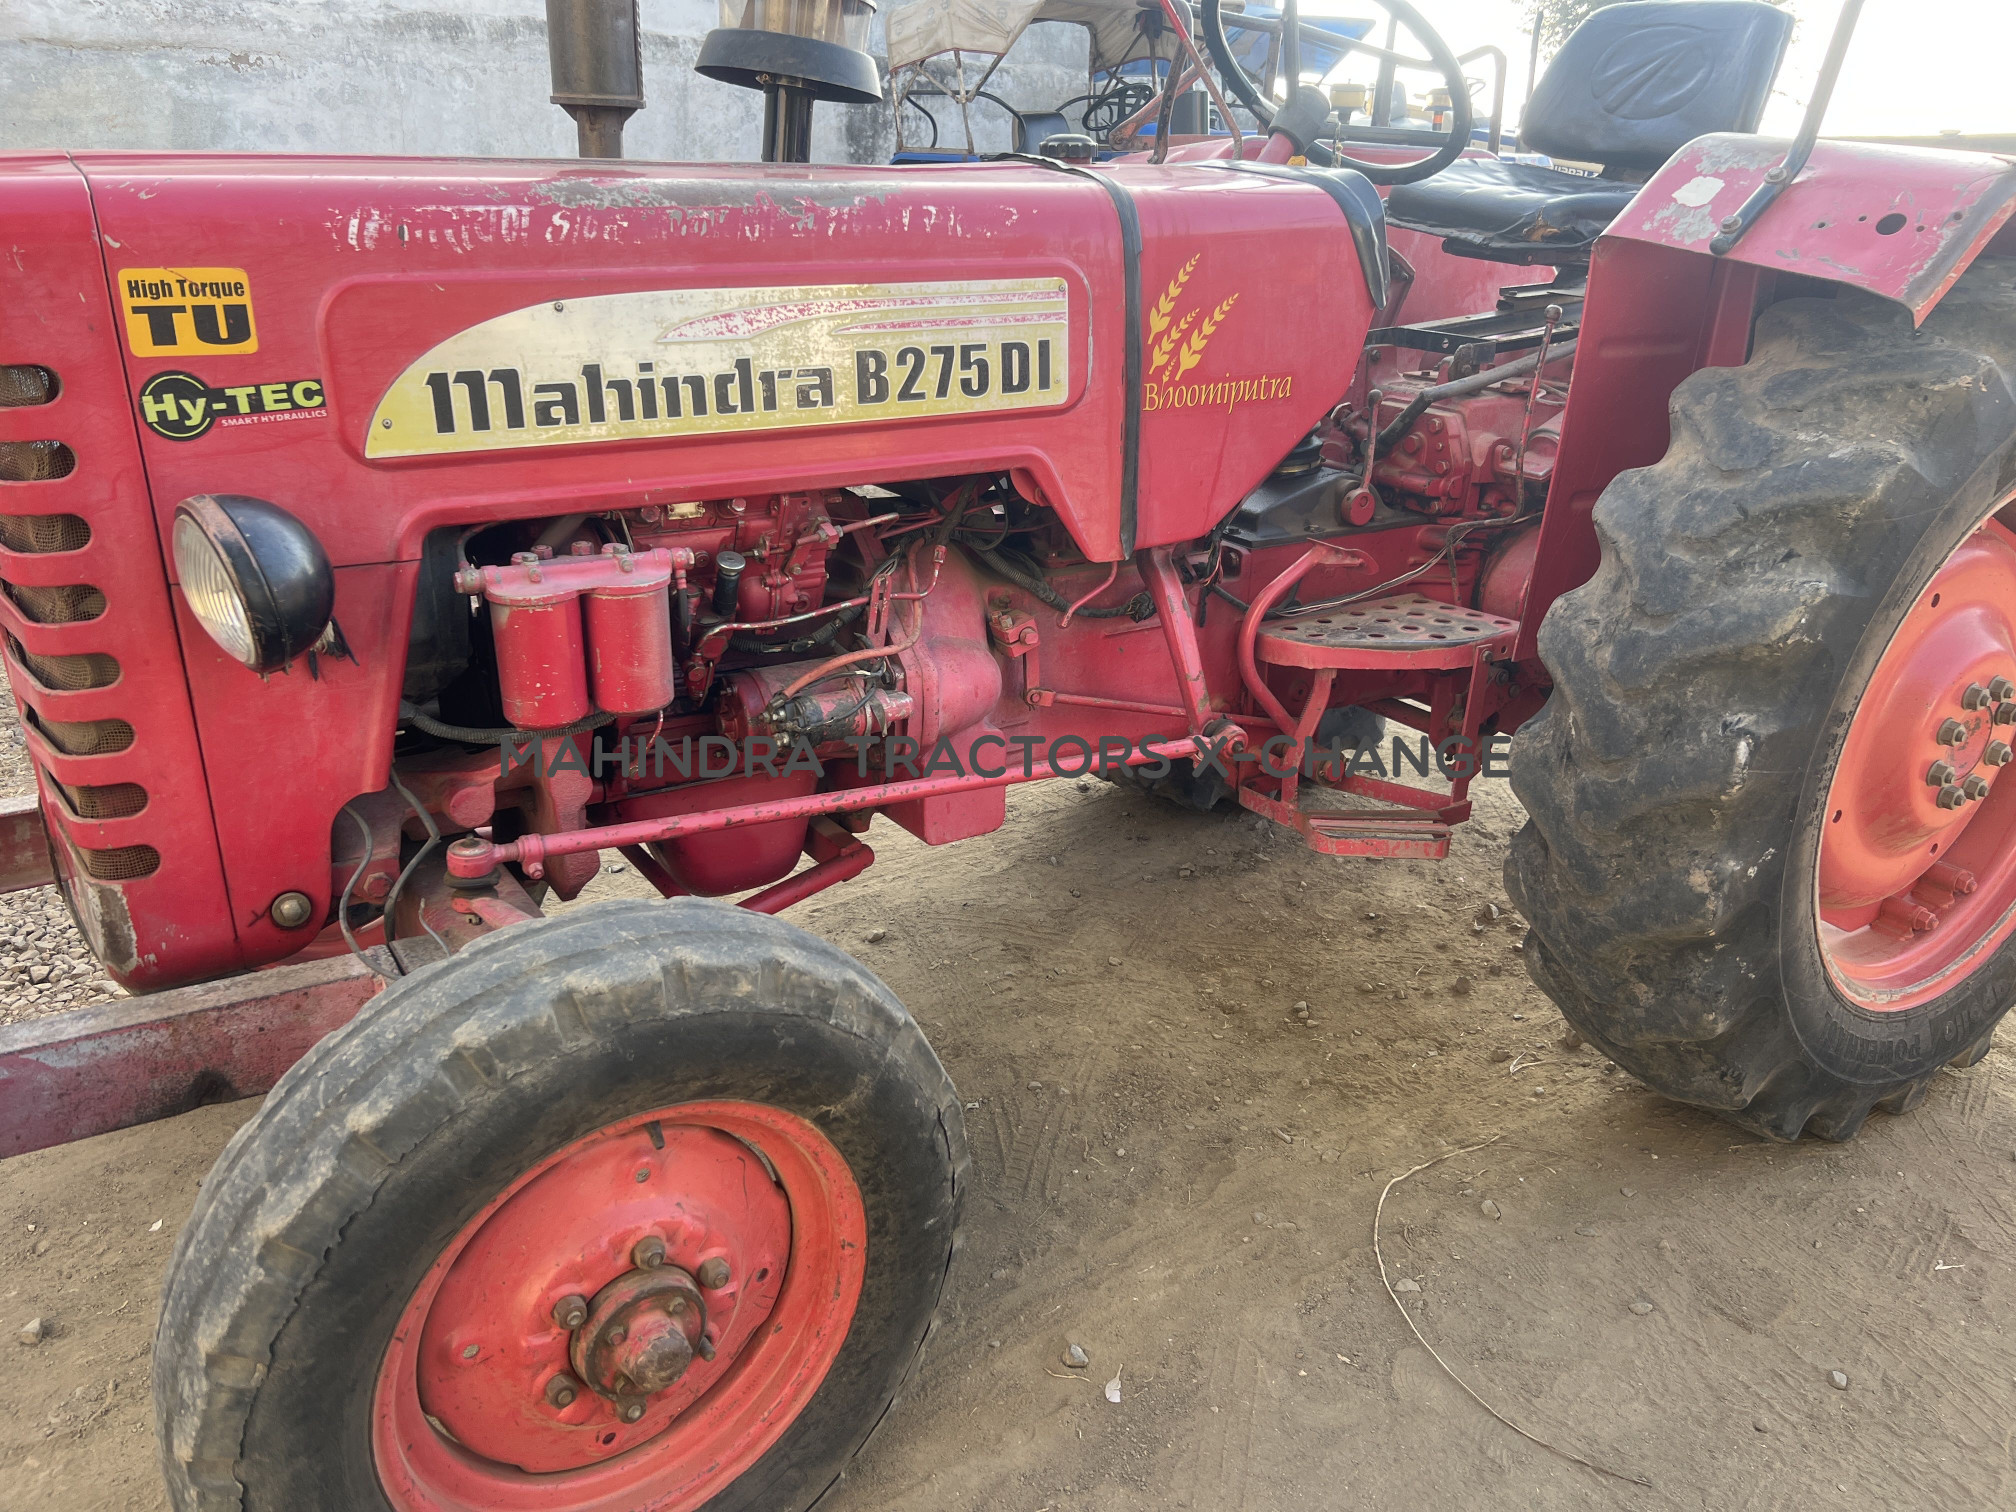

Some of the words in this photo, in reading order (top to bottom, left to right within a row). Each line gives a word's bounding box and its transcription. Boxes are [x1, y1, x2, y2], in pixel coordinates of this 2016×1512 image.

[127, 280, 173, 300] High
[176, 279, 245, 299] Torque
[131, 304, 251, 346] TU
[142, 381, 324, 426] Hy-TEC
[1143, 373, 1292, 414] Bhoomiputra
[221, 415, 259, 427] SMART
[261, 409, 327, 423] HYDRAULICS
